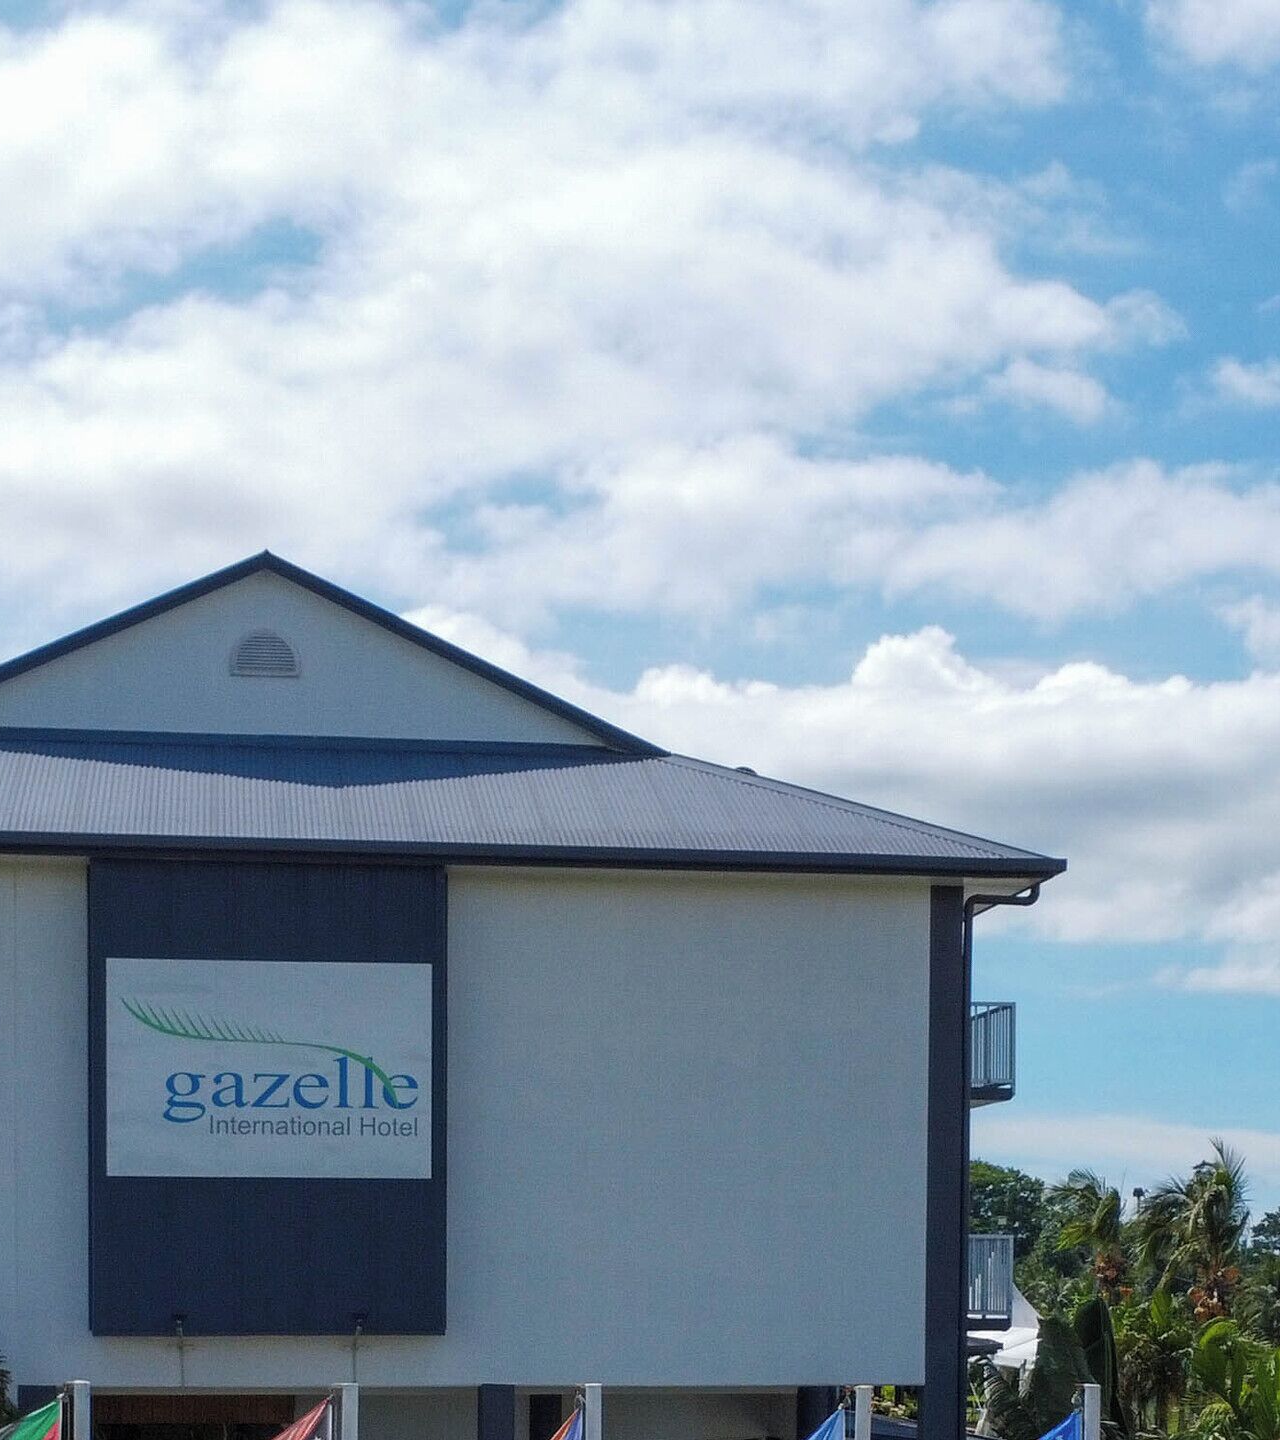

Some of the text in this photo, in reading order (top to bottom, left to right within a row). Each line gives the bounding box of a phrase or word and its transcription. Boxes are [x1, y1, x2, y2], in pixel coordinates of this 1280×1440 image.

[162, 1056, 419, 1123] gazelle
[209, 1114, 419, 1138] International Hotel
